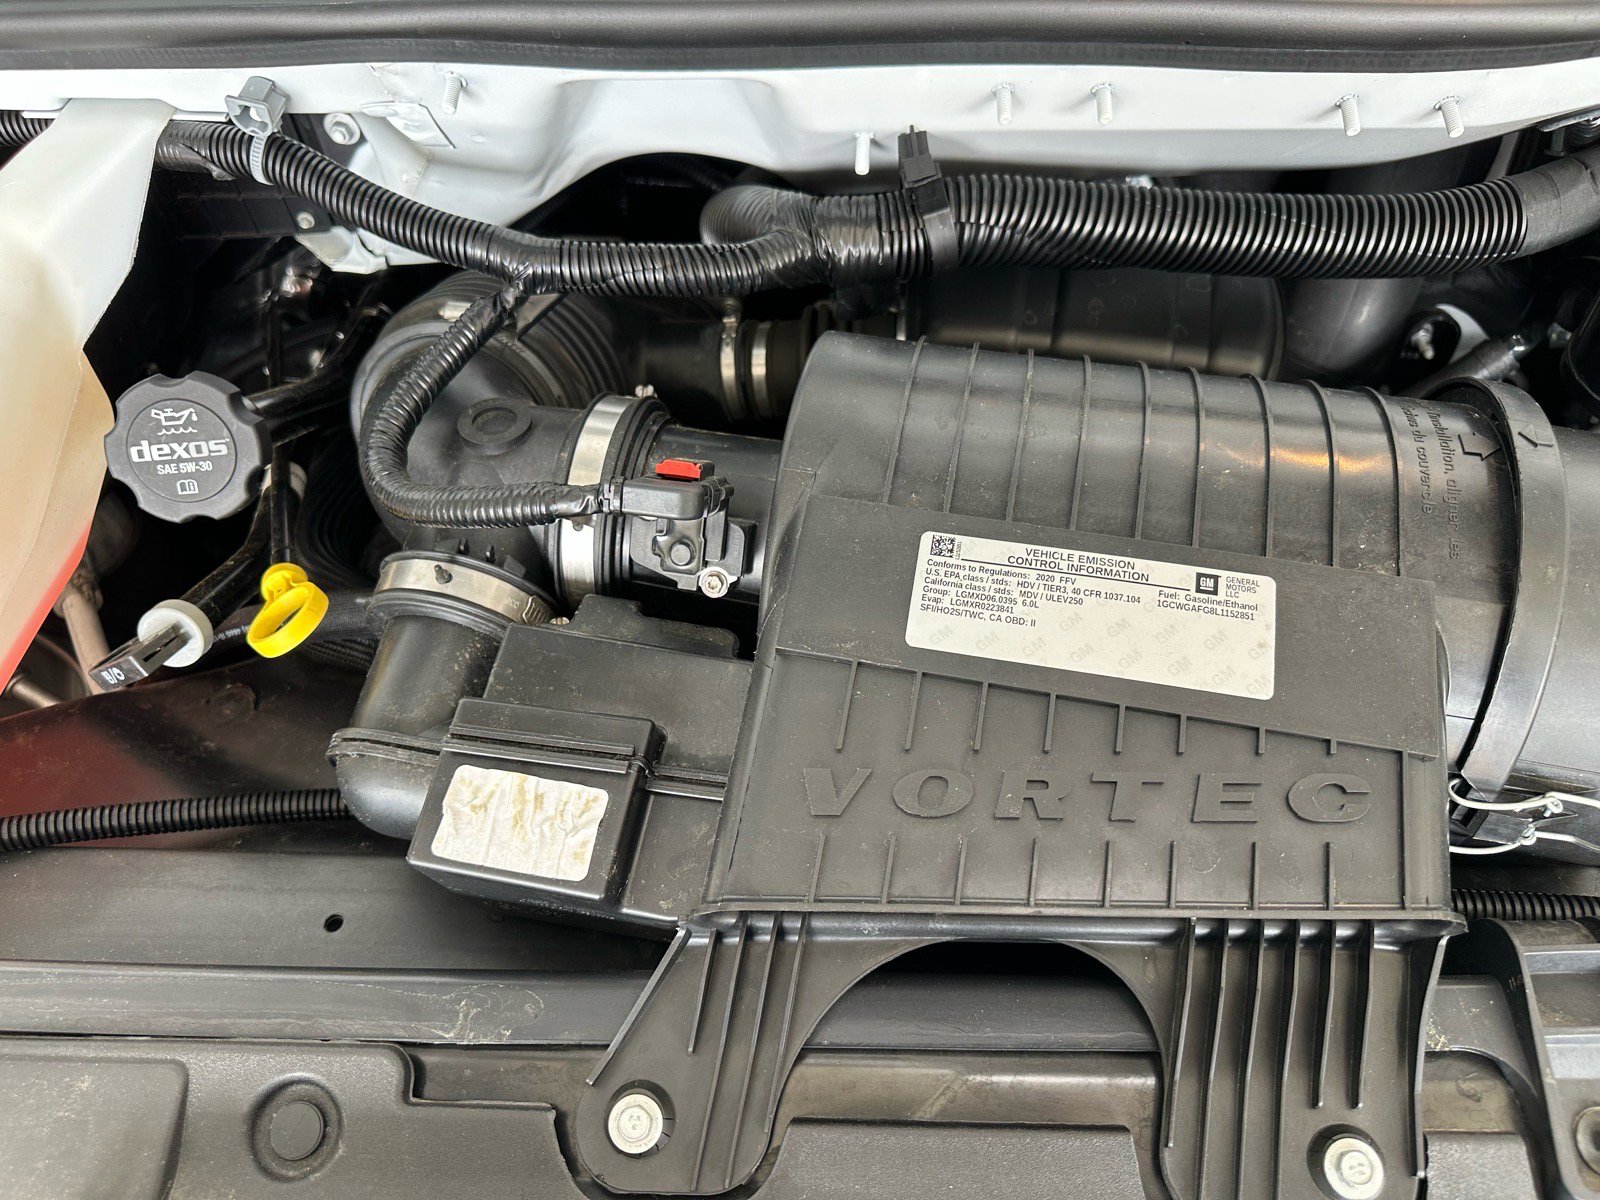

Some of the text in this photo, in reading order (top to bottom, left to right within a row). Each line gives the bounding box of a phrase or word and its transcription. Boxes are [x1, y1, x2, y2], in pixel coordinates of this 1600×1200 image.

[1412, 430, 1427, 443] du
[130, 439, 229, 463] dexos
[156, 461, 213, 475] SAE 5W-30
[1416, 446, 1437, 514] couvercle
[1443, 479, 1463, 531] aligner
[1025, 548, 1135, 570] VEHICLE EMISSION
[1449, 537, 1464, 560] les
[927, 559, 1077, 586] Conforms to Regulations: 2020 FFV
[1007, 555, 1150, 582] CONTROL INFORMATION
[924, 576, 963, 589] California
[964, 581, 987, 592] class
[993, 586, 1014, 596] stds:
[1018, 590, 1039, 600] MDV
[1045, 593, 1084, 606] ULEV250
[925, 568, 942, 577] U.S.
[962, 573, 984, 584] class
[991, 577, 1012, 587] stds:
[1017, 580, 1036, 591] HDV
[1043, 583, 1069, 595] TIER3,
[1071, 588, 1081, 596] 40
[1083, 589, 1102, 599] CFR
[1104, 591, 1141, 604] 1037.104
[1200, 577, 1214, 588] GM
[1225, 576, 1260, 588] GENERAL
[1225, 584, 1257, 594] MOTORS
[921, 594, 1014, 614] Evap: LGMXR0223841
[923, 585, 1039, 609] Group: LGMXD06.0395 6.0L
[1158, 590, 1258, 611] Fuel: Gasoline/Ethanol
[1225, 591, 1240, 599] LLC
[920, 603, 986, 621] SFI/HO2S/TWC,
[989, 613, 1002, 622] CA
[1004, 615, 1028, 627] OBD:
[1157, 600, 1255, 621] 1GCWGAFG8L1152851
[1059, 612, 1084, 632] GM
[1106, 617, 1132, 638] GM
[930, 624, 954, 646] GM
[975, 630, 999, 651] GM
[1155, 623, 1180, 644] GM
[1203, 629, 1229, 650] GM
[1023, 637, 1047, 658] GM
[1070, 642, 1095, 664] GM
[1248, 642, 1271, 661] GM
[1118, 648, 1143, 669] GM
[1167, 655, 1193, 676] GM
[1212, 664, 1237, 686] GM
[1246, 673, 1271, 695] GM
[802, 767, 1372, 823] VORTEC
